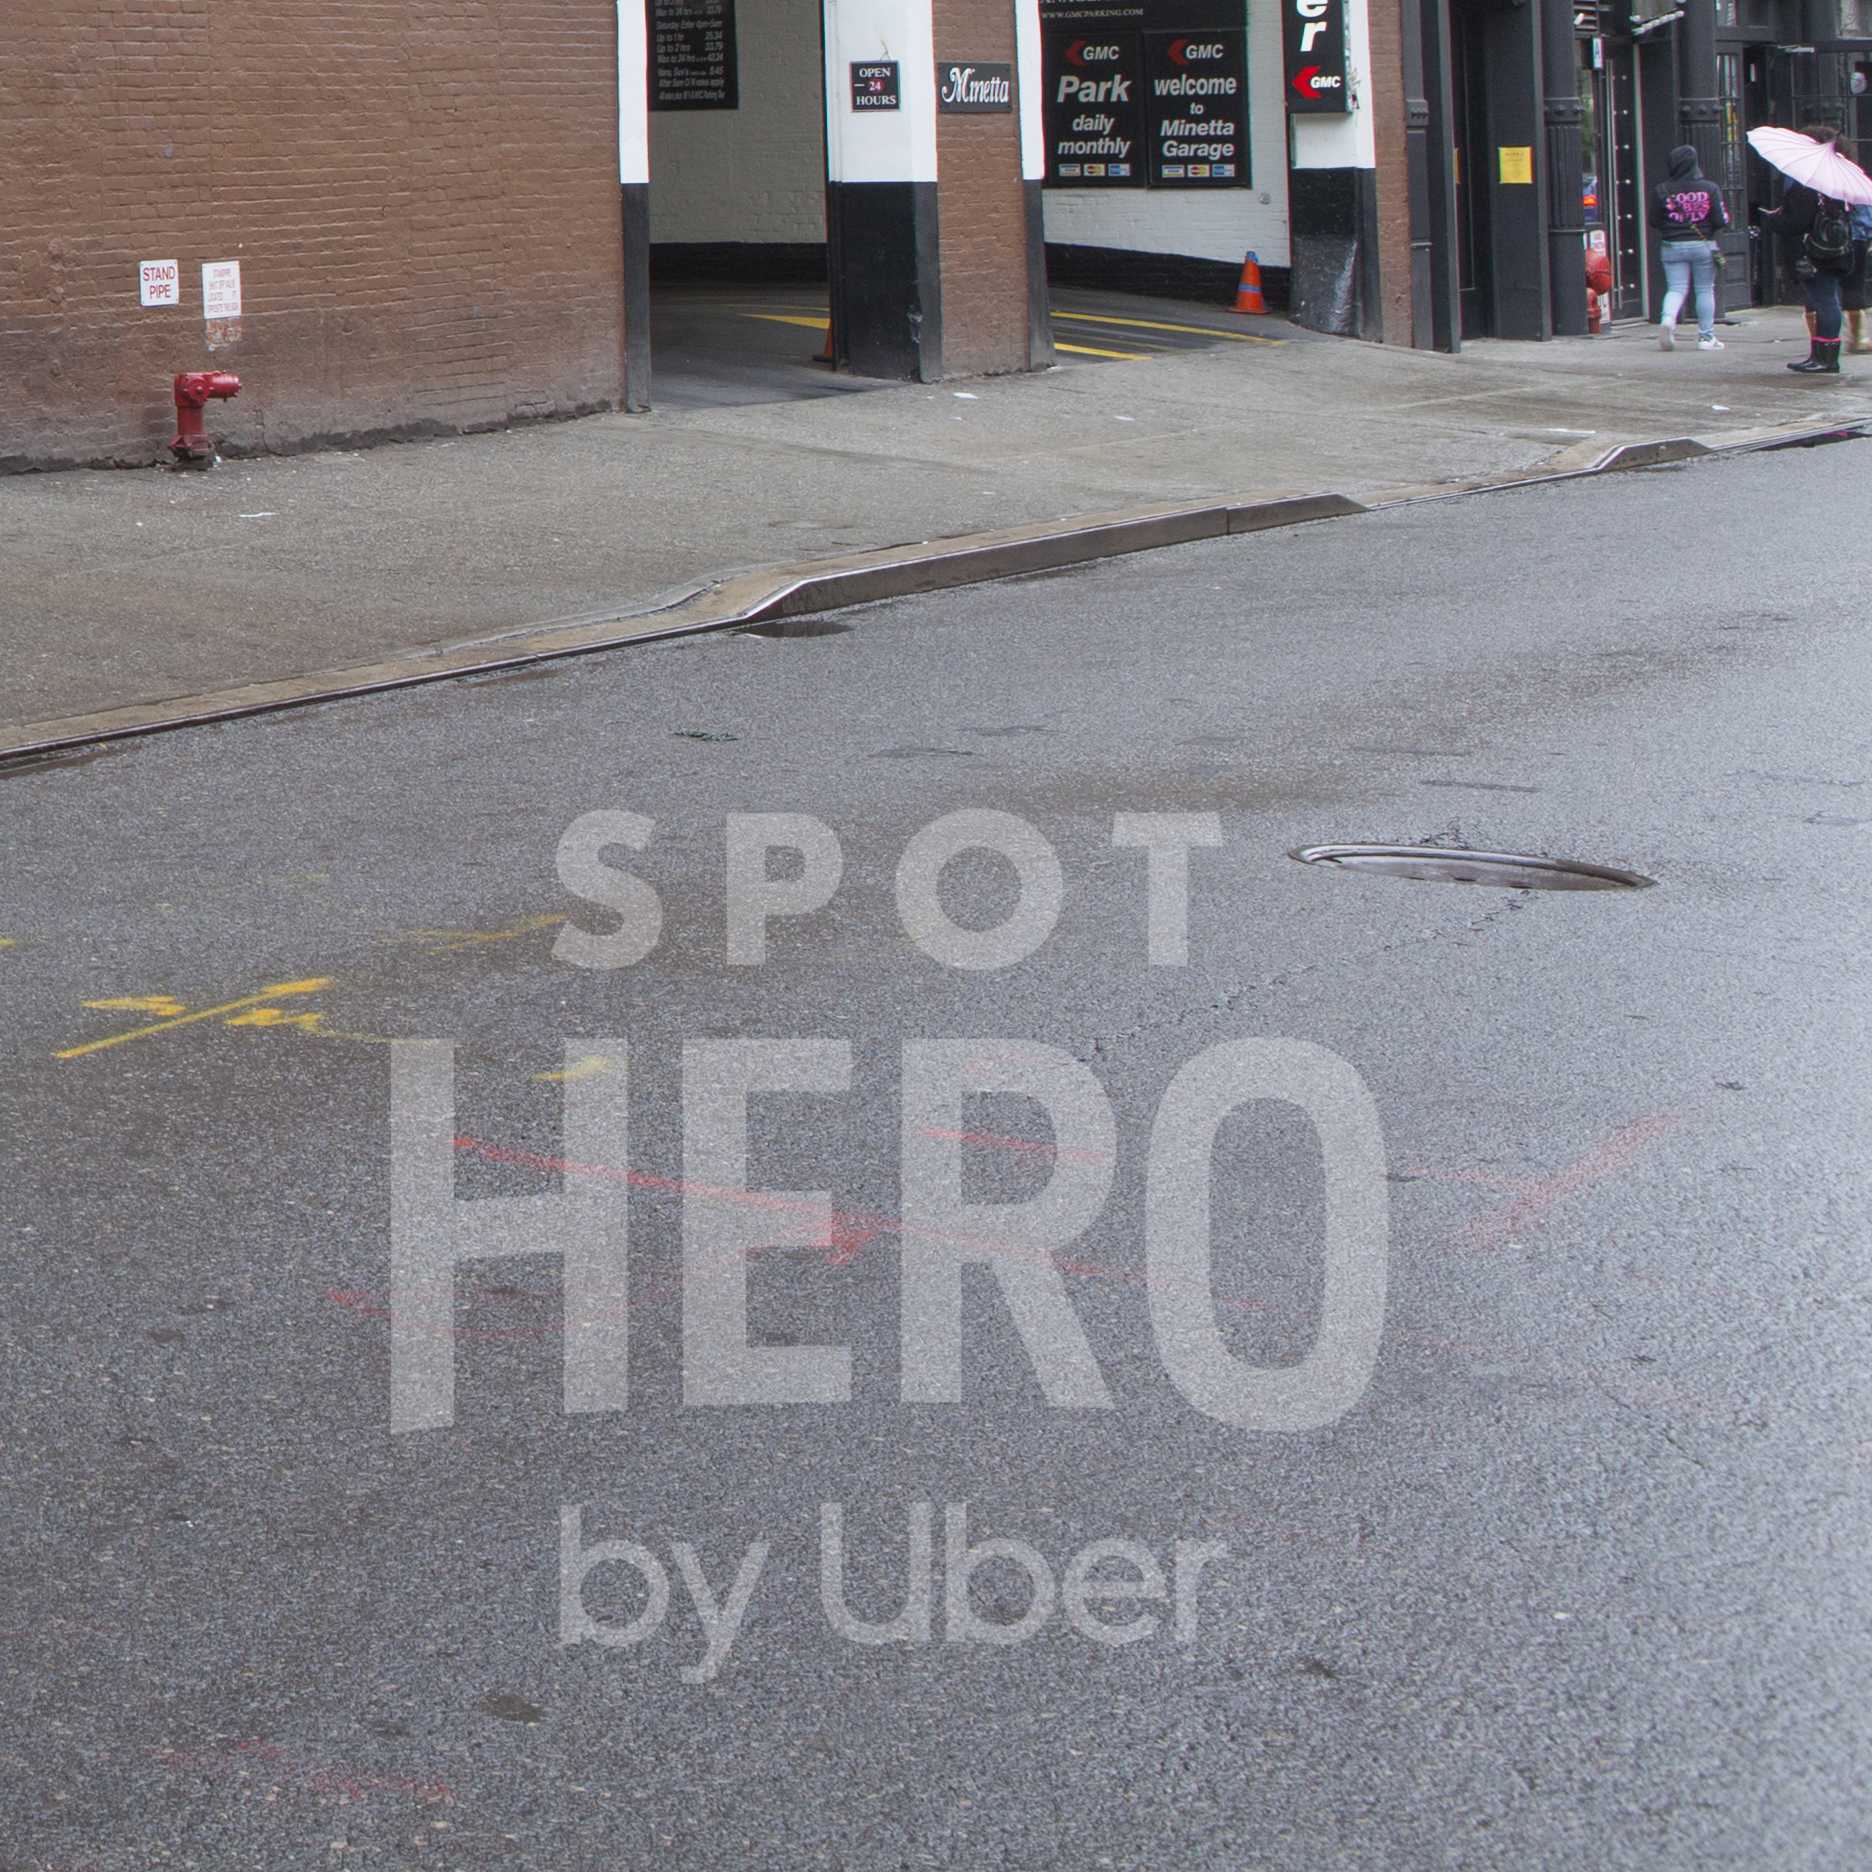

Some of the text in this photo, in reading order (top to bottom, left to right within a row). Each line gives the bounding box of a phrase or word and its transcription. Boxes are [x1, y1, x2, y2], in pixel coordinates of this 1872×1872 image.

[1082, 45, 1120, 61] GMC
[1185, 44, 1224, 60] GMC
[859, 67, 891, 78] OPEN
[869, 81, 881, 92] 24
[941, 66, 1010, 104] Minetta
[1056, 74, 1132, 104] Park
[1155, 73, 1238, 96] welcome
[1310, 75, 1341, 89] GMC
[856, 95, 896, 106] HOURS
[1189, 102, 1204, 115] to
[1072, 113, 1115, 135] daily
[1160, 119, 1235, 137] Minetta
[1057, 136, 1132, 158] monthly
[1162, 140, 1235, 161] Garage
[143, 266, 176, 282] STAND
[149, 284, 172, 300] PIPE
